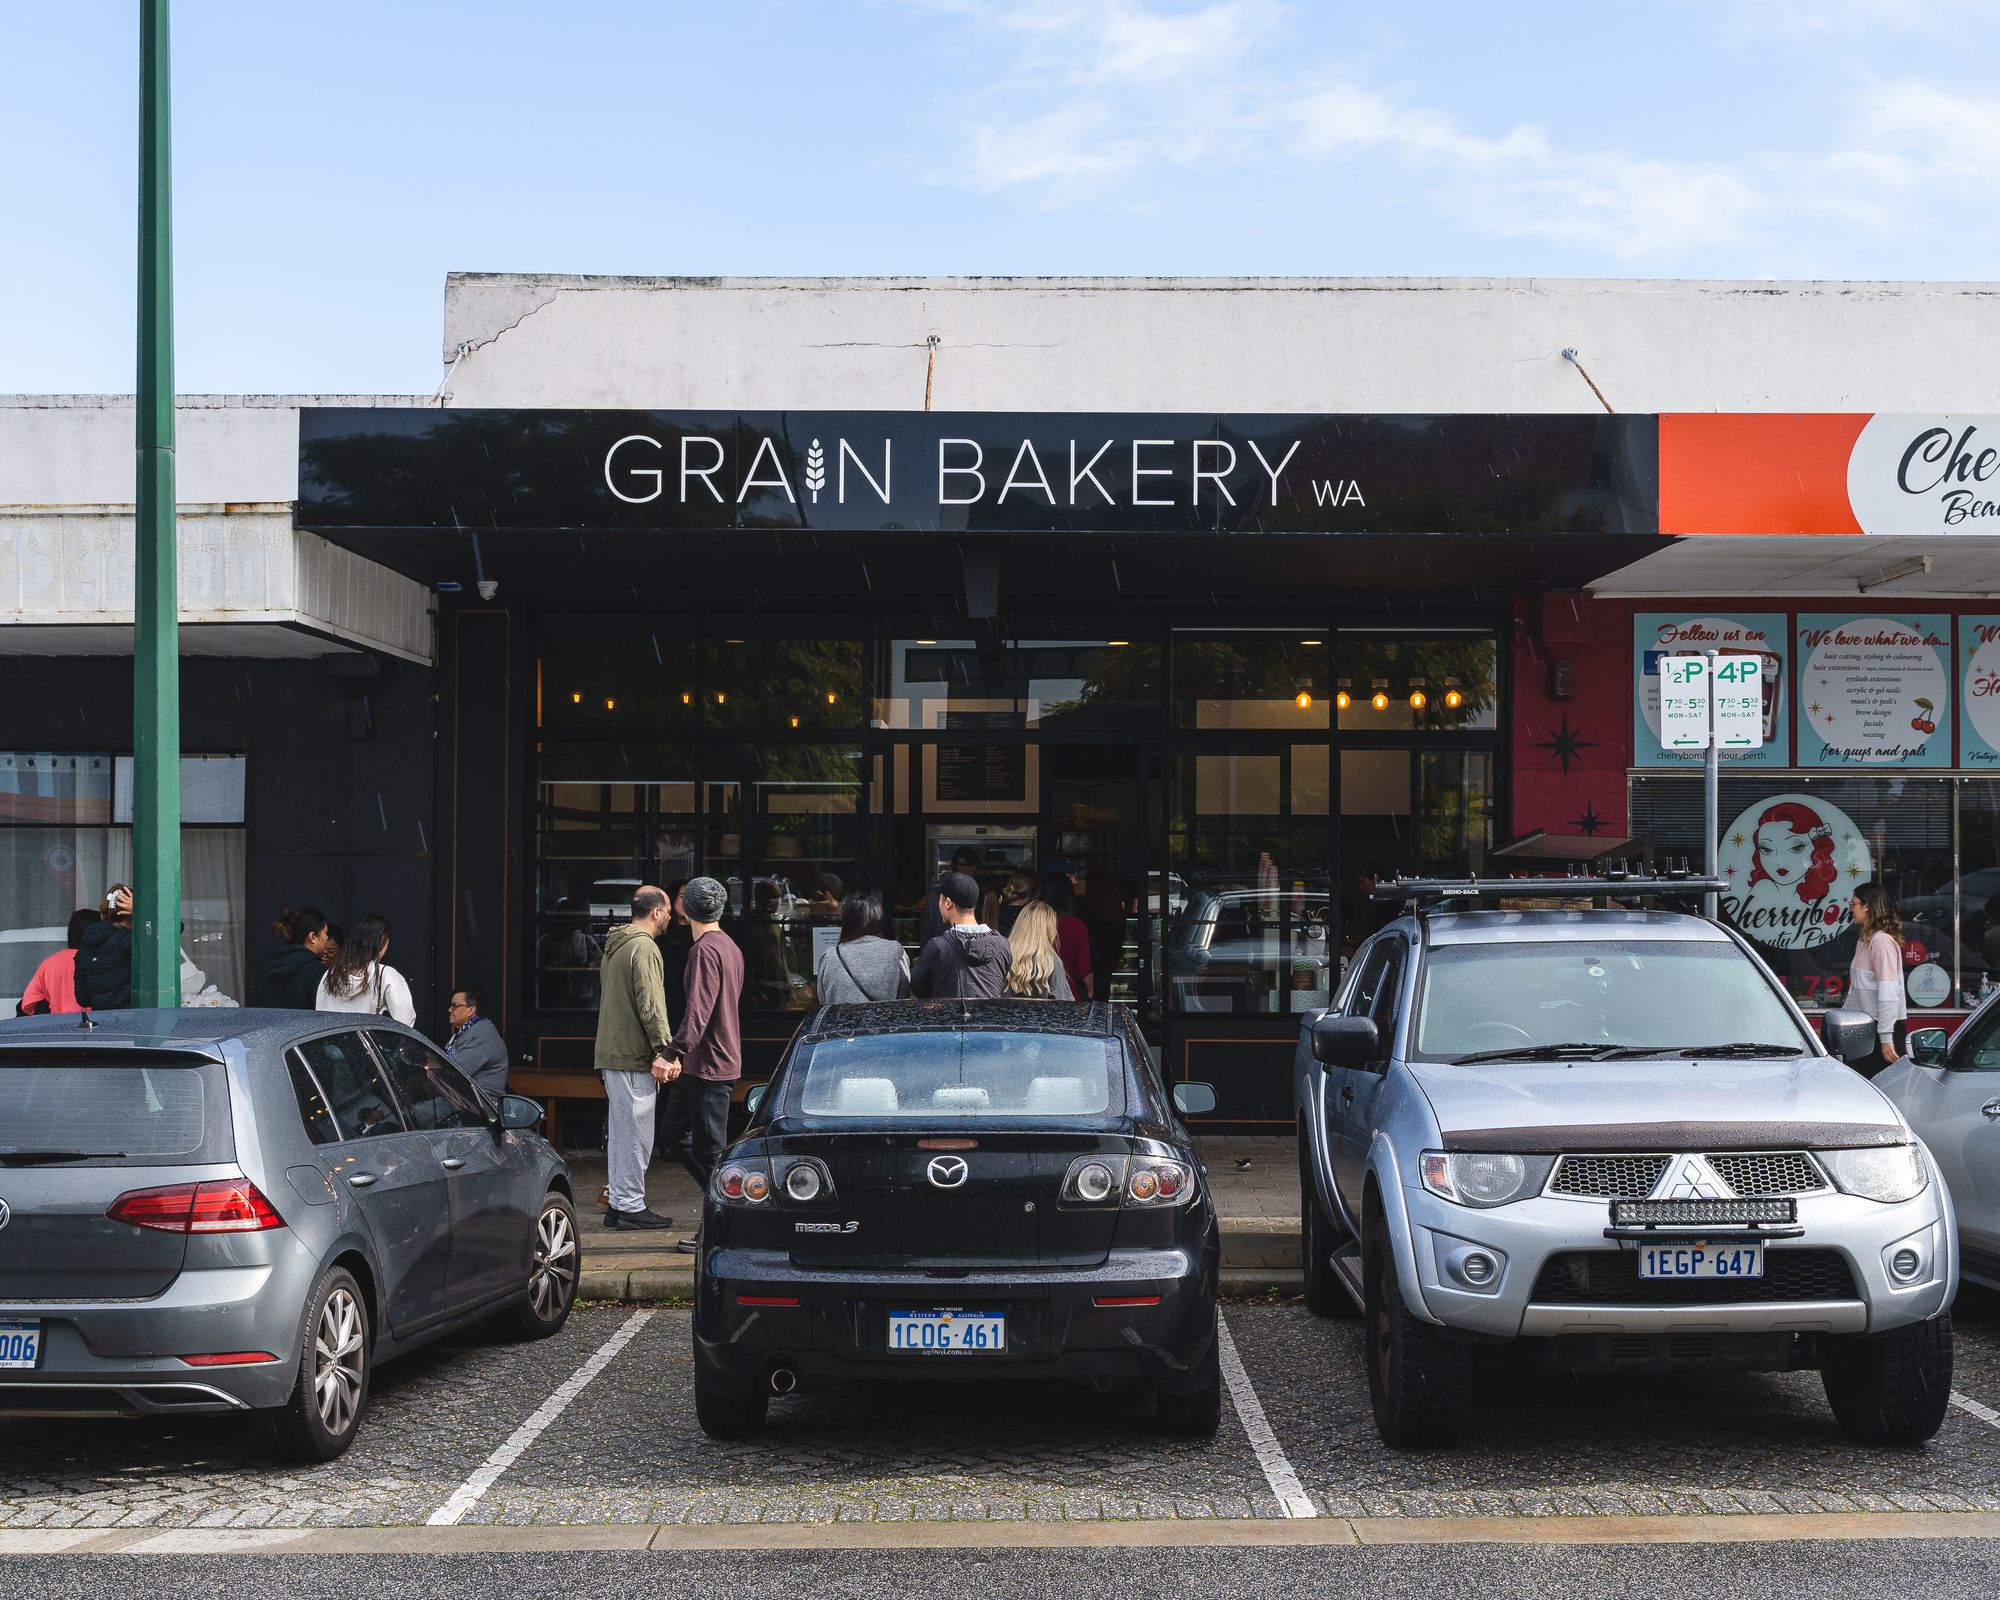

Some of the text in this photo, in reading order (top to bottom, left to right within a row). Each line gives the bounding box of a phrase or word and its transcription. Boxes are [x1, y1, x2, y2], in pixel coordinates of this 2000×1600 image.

[938, 438, 1301, 506] BAKERY
[1311, 479, 1366, 507] WA
[1941, 489, 2000, 525] Bea
[1657, 623, 1767, 644] Follow us on
[1798, 628, 1833, 648] We
[1835, 630, 1862, 647] love
[1863, 630, 1905, 646] what
[1901, 635, 1921, 646] we
[1824, 652, 1837, 660] hair
[1864, 652, 1884, 661] styling
[1893, 652, 1923, 661] colouring
[1717, 661, 1758, 684] 4P
[1846, 675, 1868, 683] eyelash
[1846, 686, 1868, 694] acrylic
[1875, 686, 1885, 695] gel
[1885, 686, 1901, 694] nails
[1855, 708, 1892, 717] brow design
[1862, 720, 1884, 728] facials
[1820, 742, 1926, 762] for guys and gals
